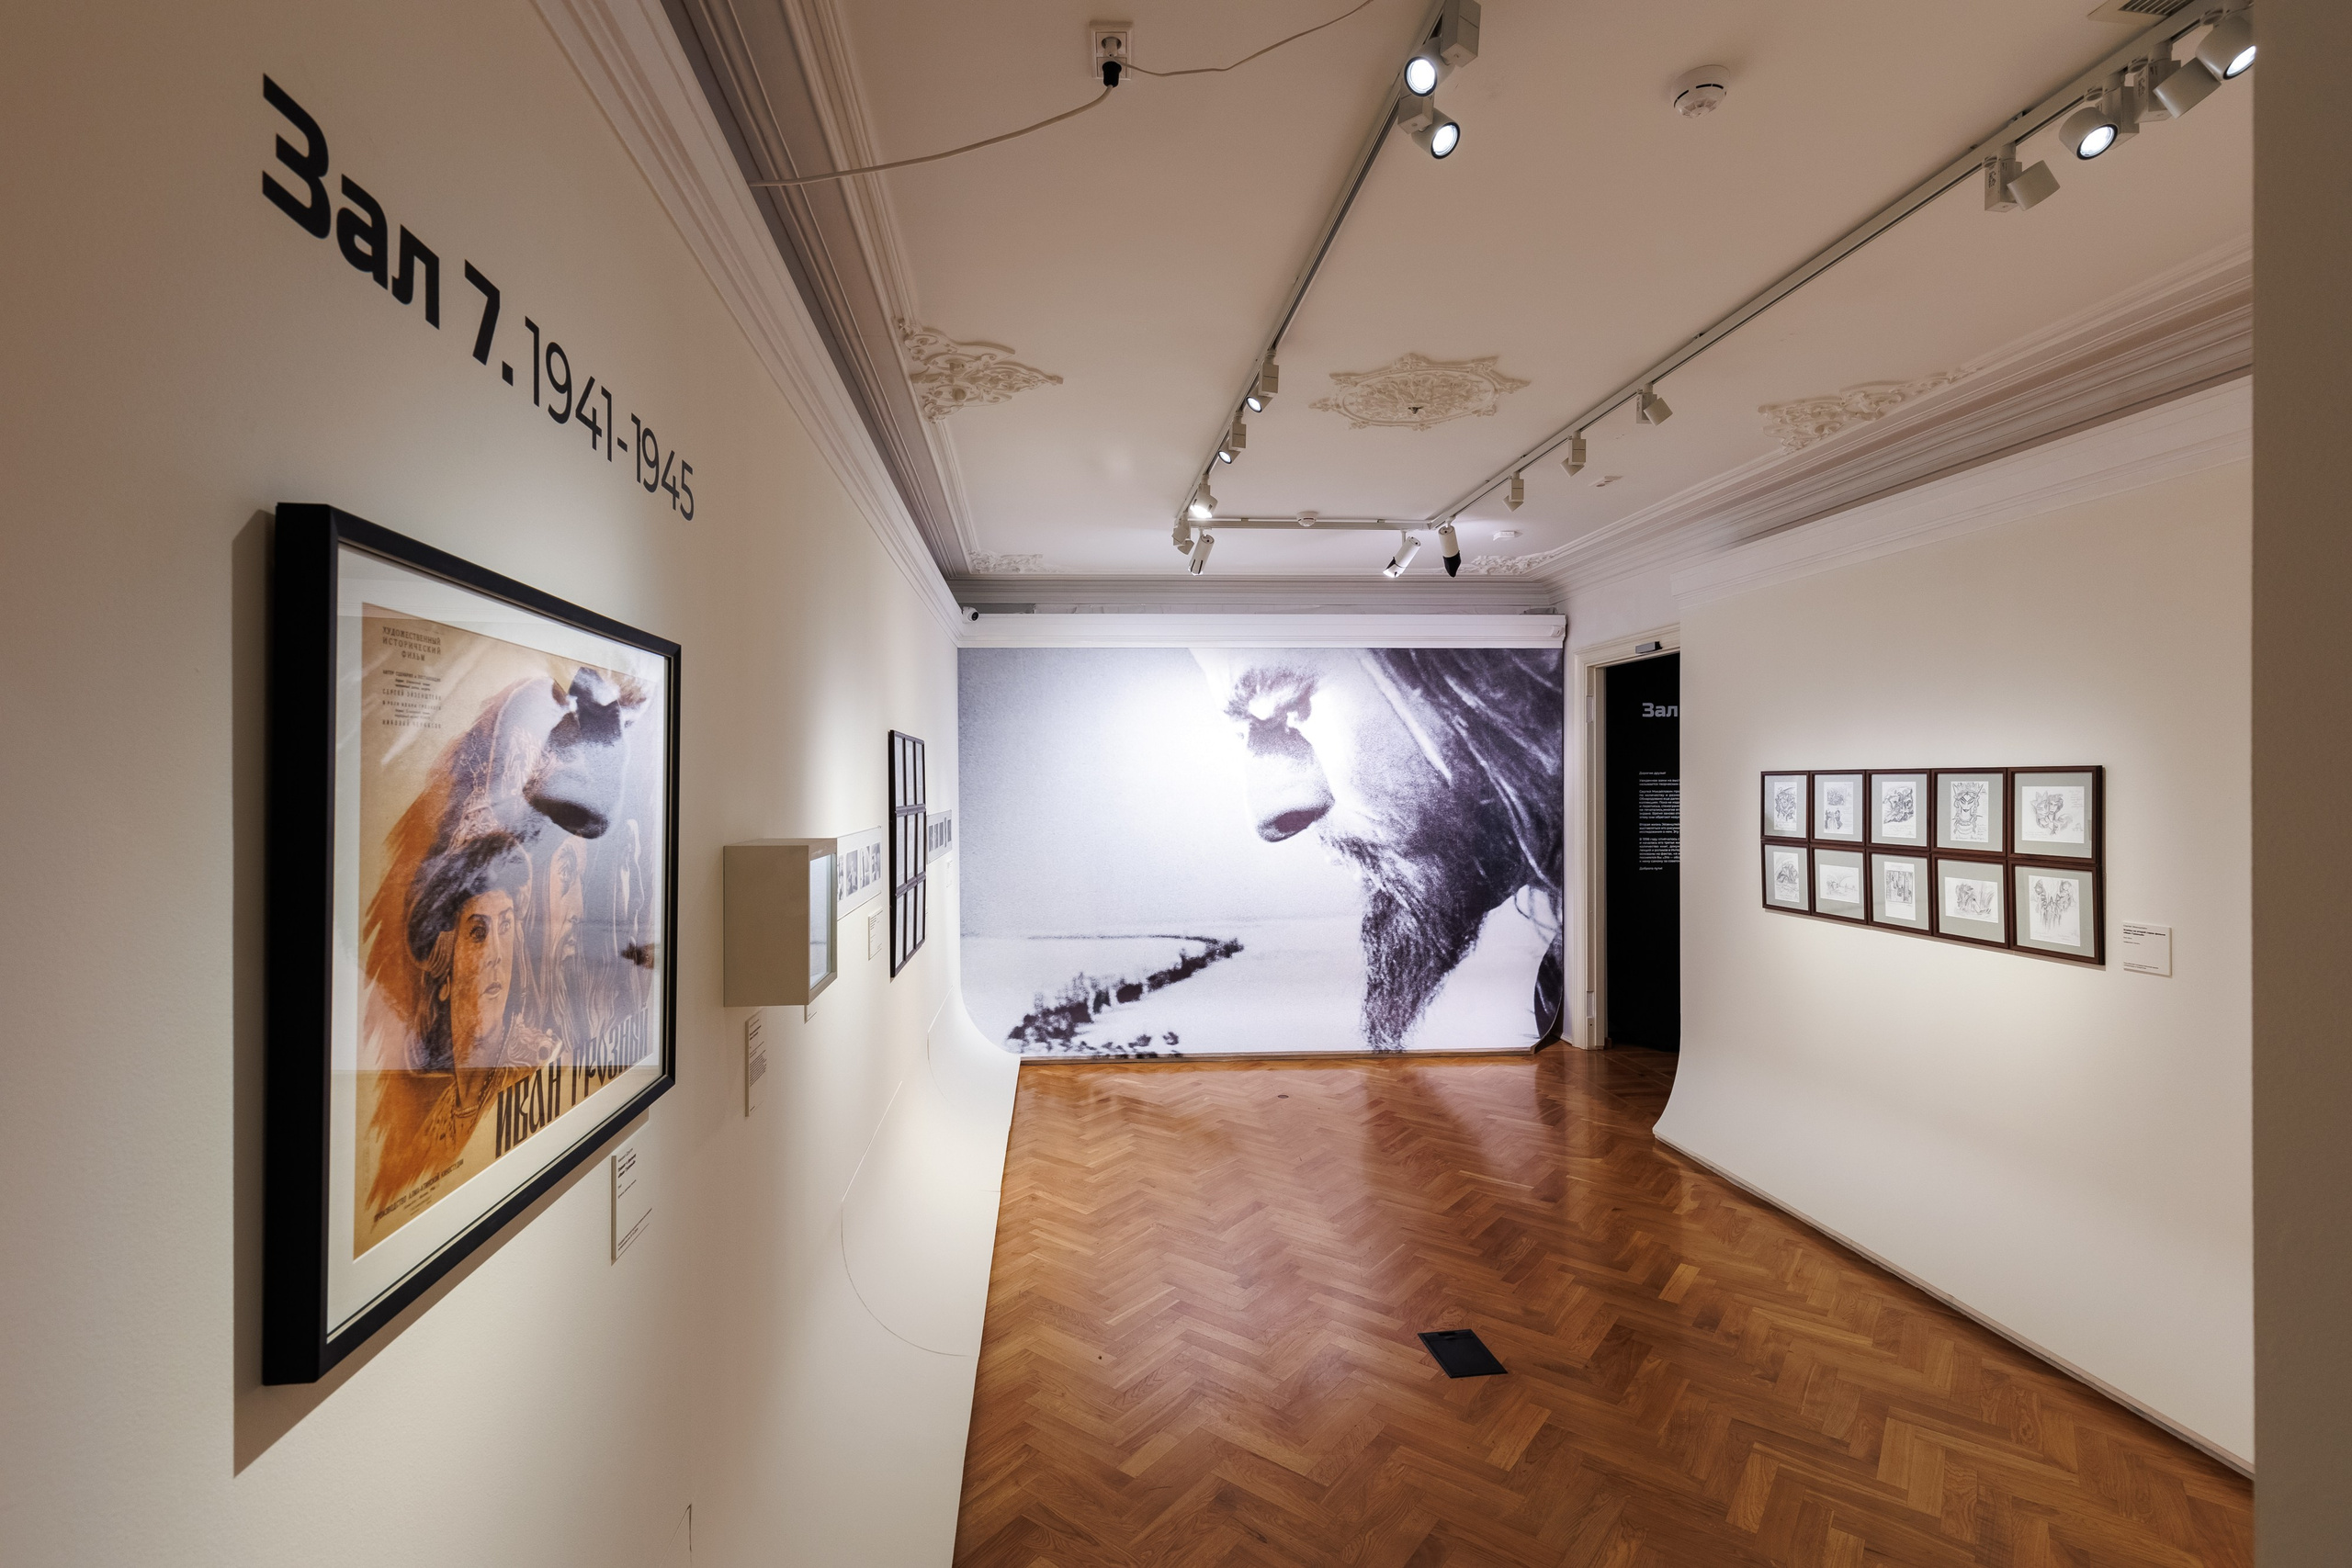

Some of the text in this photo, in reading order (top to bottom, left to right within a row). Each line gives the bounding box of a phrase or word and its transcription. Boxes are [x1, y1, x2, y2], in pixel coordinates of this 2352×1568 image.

[262, 72, 440, 331] Зал
[525, 315, 695, 522] 1941-1945
[382, 626, 441, 646] ХУДОЖЕСТВЕННЫЙ
[382, 637, 441, 655] ИСТОРИЧЕСКИЙ
[401, 650, 425, 661] ФИЛЬМ
[1642, 702, 1679, 717] Зал
[495, 1056, 561, 1159] ИВАН
[571, 1002, 649, 1107] ГРОЗНЫЙ
